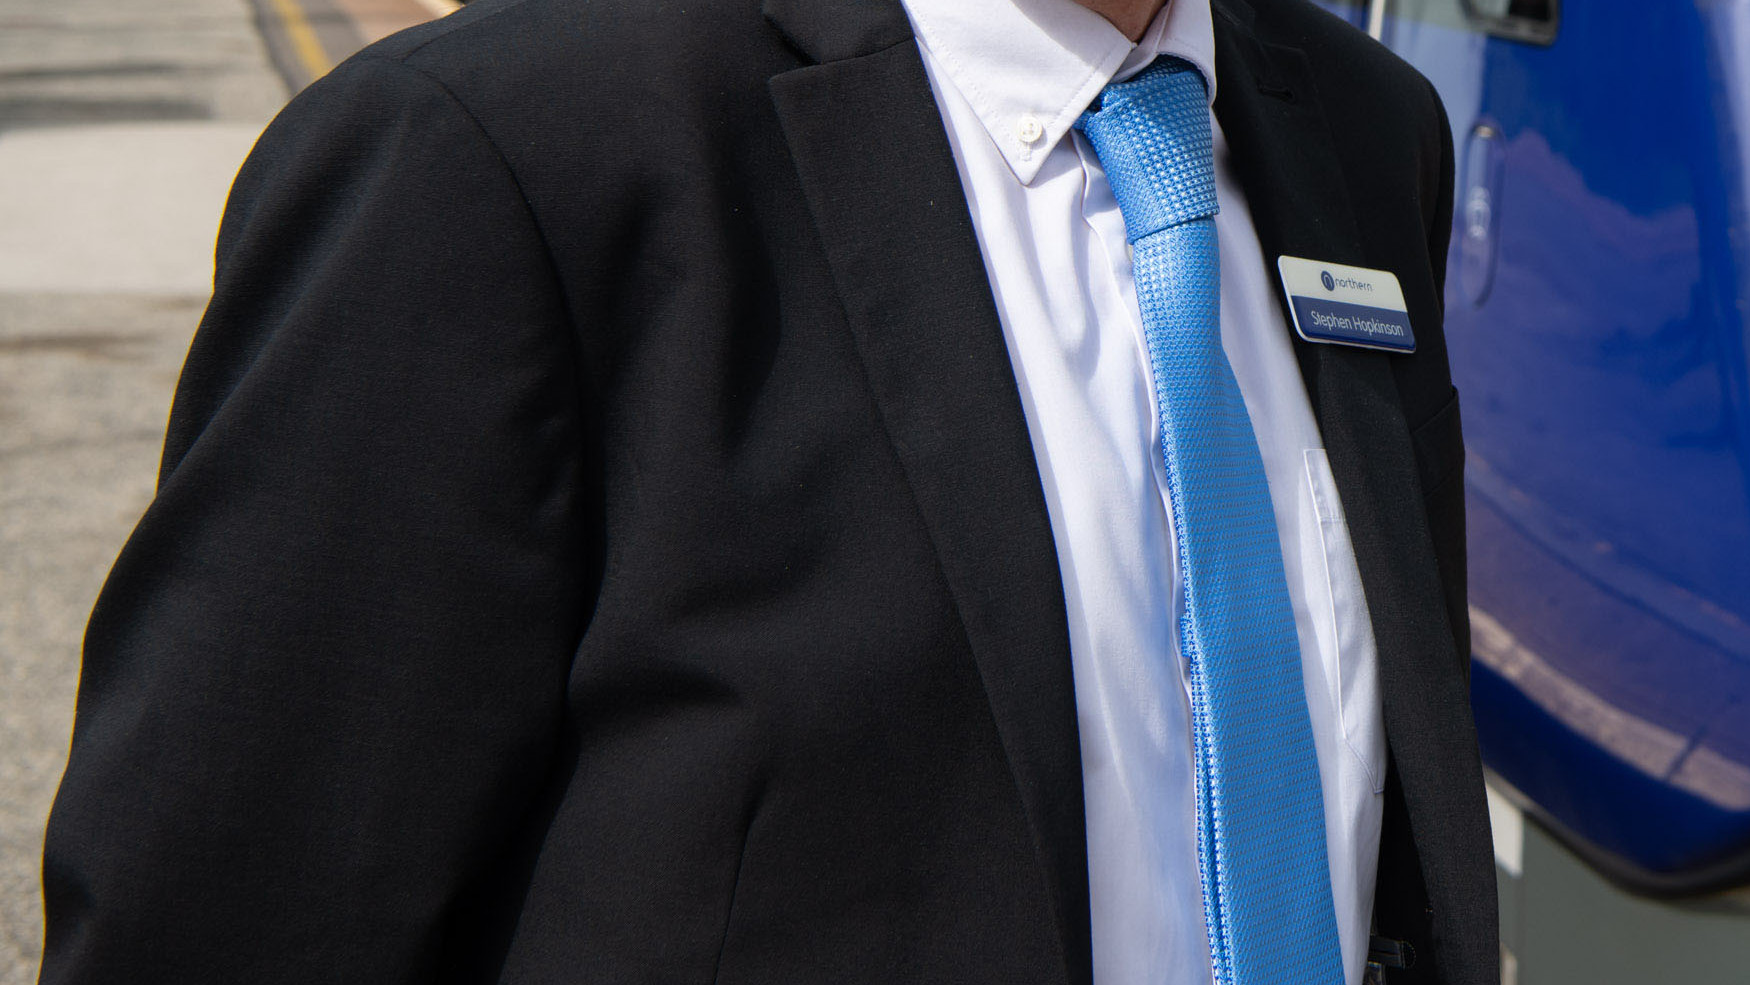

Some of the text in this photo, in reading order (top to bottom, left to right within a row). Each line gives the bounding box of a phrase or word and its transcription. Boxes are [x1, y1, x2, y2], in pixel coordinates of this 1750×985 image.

[1335, 277, 1373, 292] northern
[1310, 310, 1404, 337] Stephen Hopkinson
